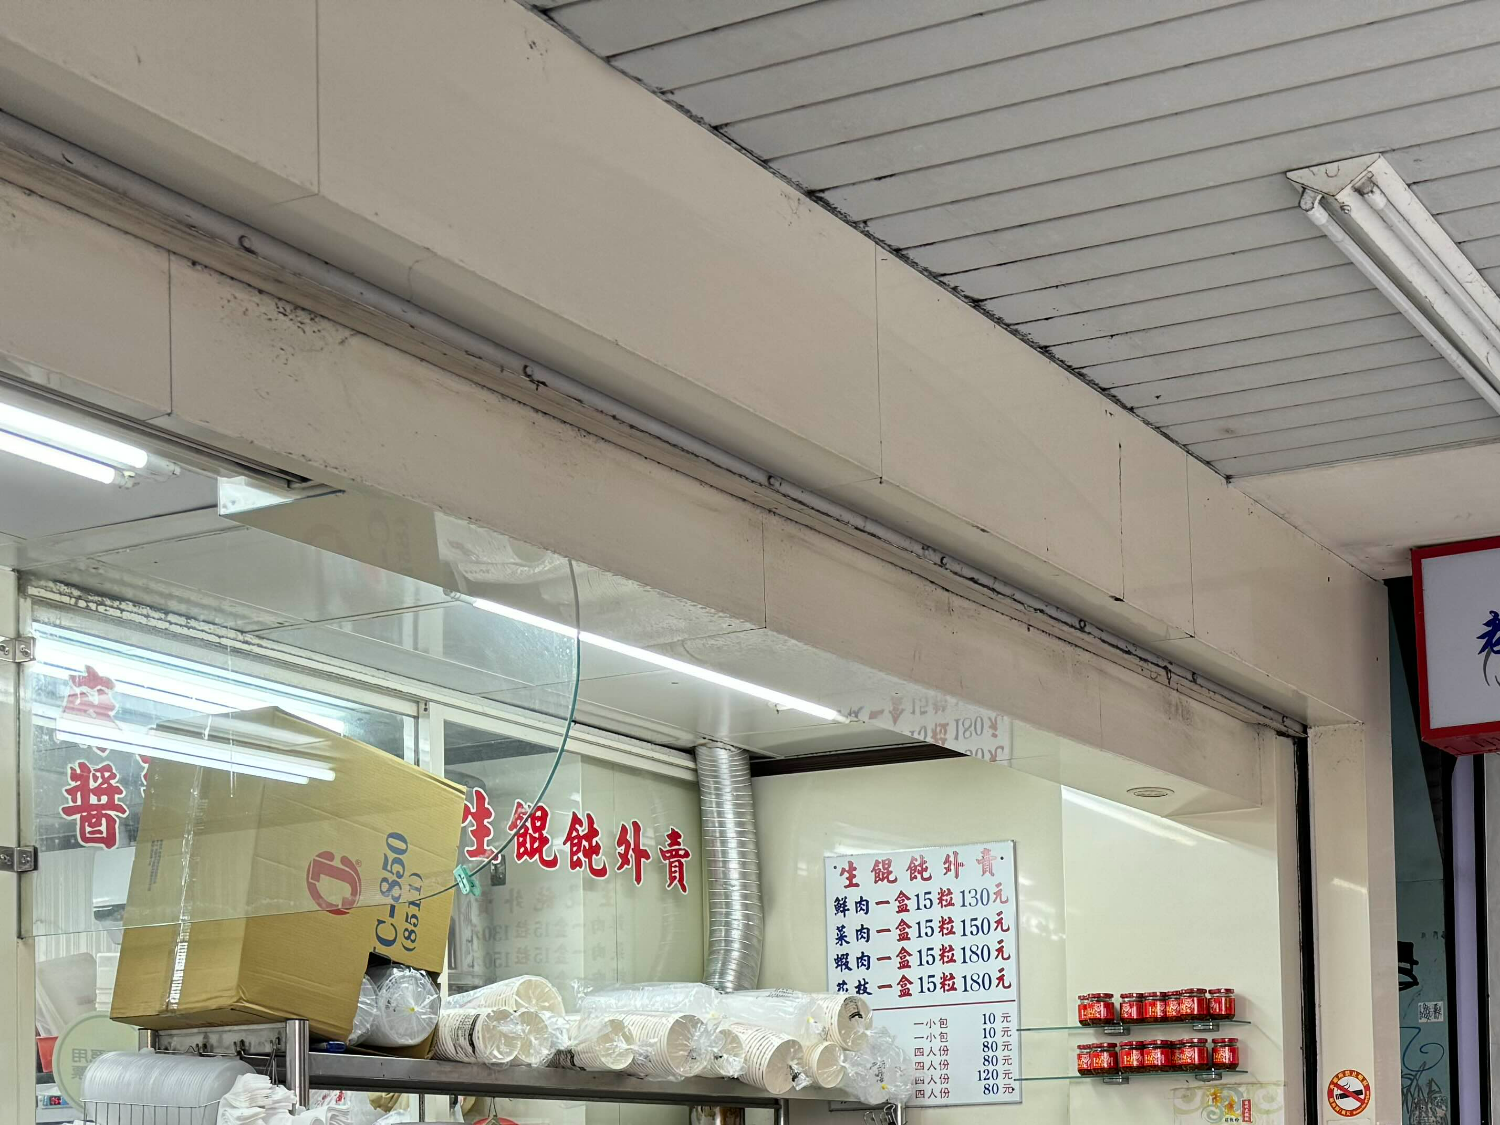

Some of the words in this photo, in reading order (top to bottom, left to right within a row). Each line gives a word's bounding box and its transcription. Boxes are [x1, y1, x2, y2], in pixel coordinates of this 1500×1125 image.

[462, 788, 691, 894] 生餛飩外賣
[373, 831, 409, 952] C-850
[834, 882, 1009, 918] 鮮肉一盒15粒130元
[835, 911, 1010, 946] 菜肉一盒15粒150元
[834, 939, 1011, 972] 蝦肉一盒15粒180元
